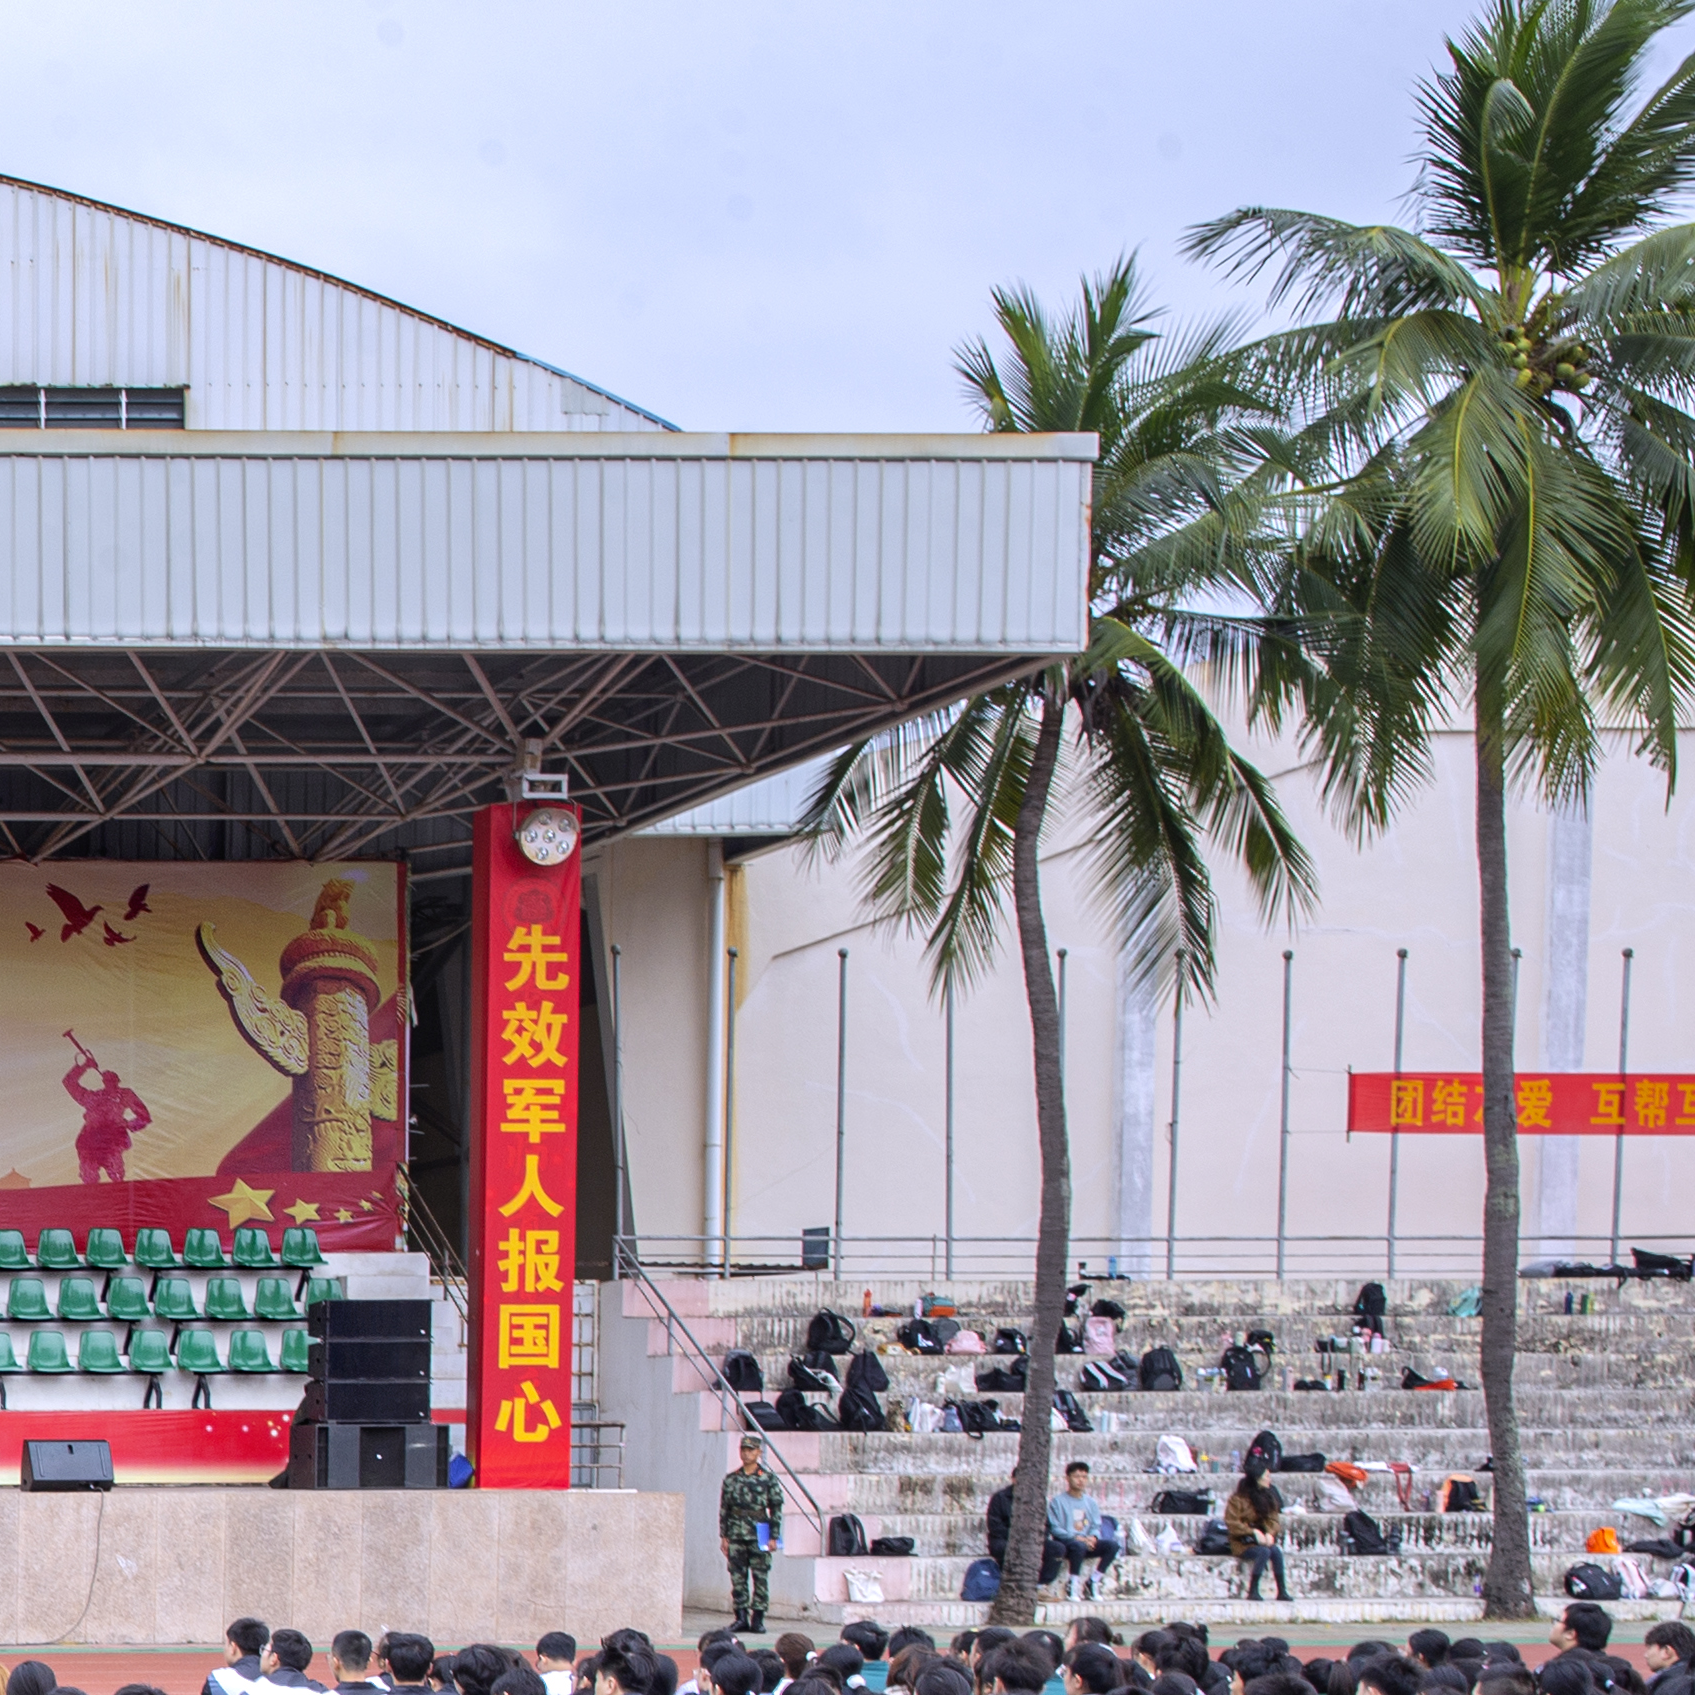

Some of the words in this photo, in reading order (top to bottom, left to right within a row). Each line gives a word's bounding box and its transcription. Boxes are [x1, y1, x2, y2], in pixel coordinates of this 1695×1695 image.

[494, 925, 570, 1443] 先效军人报国心
